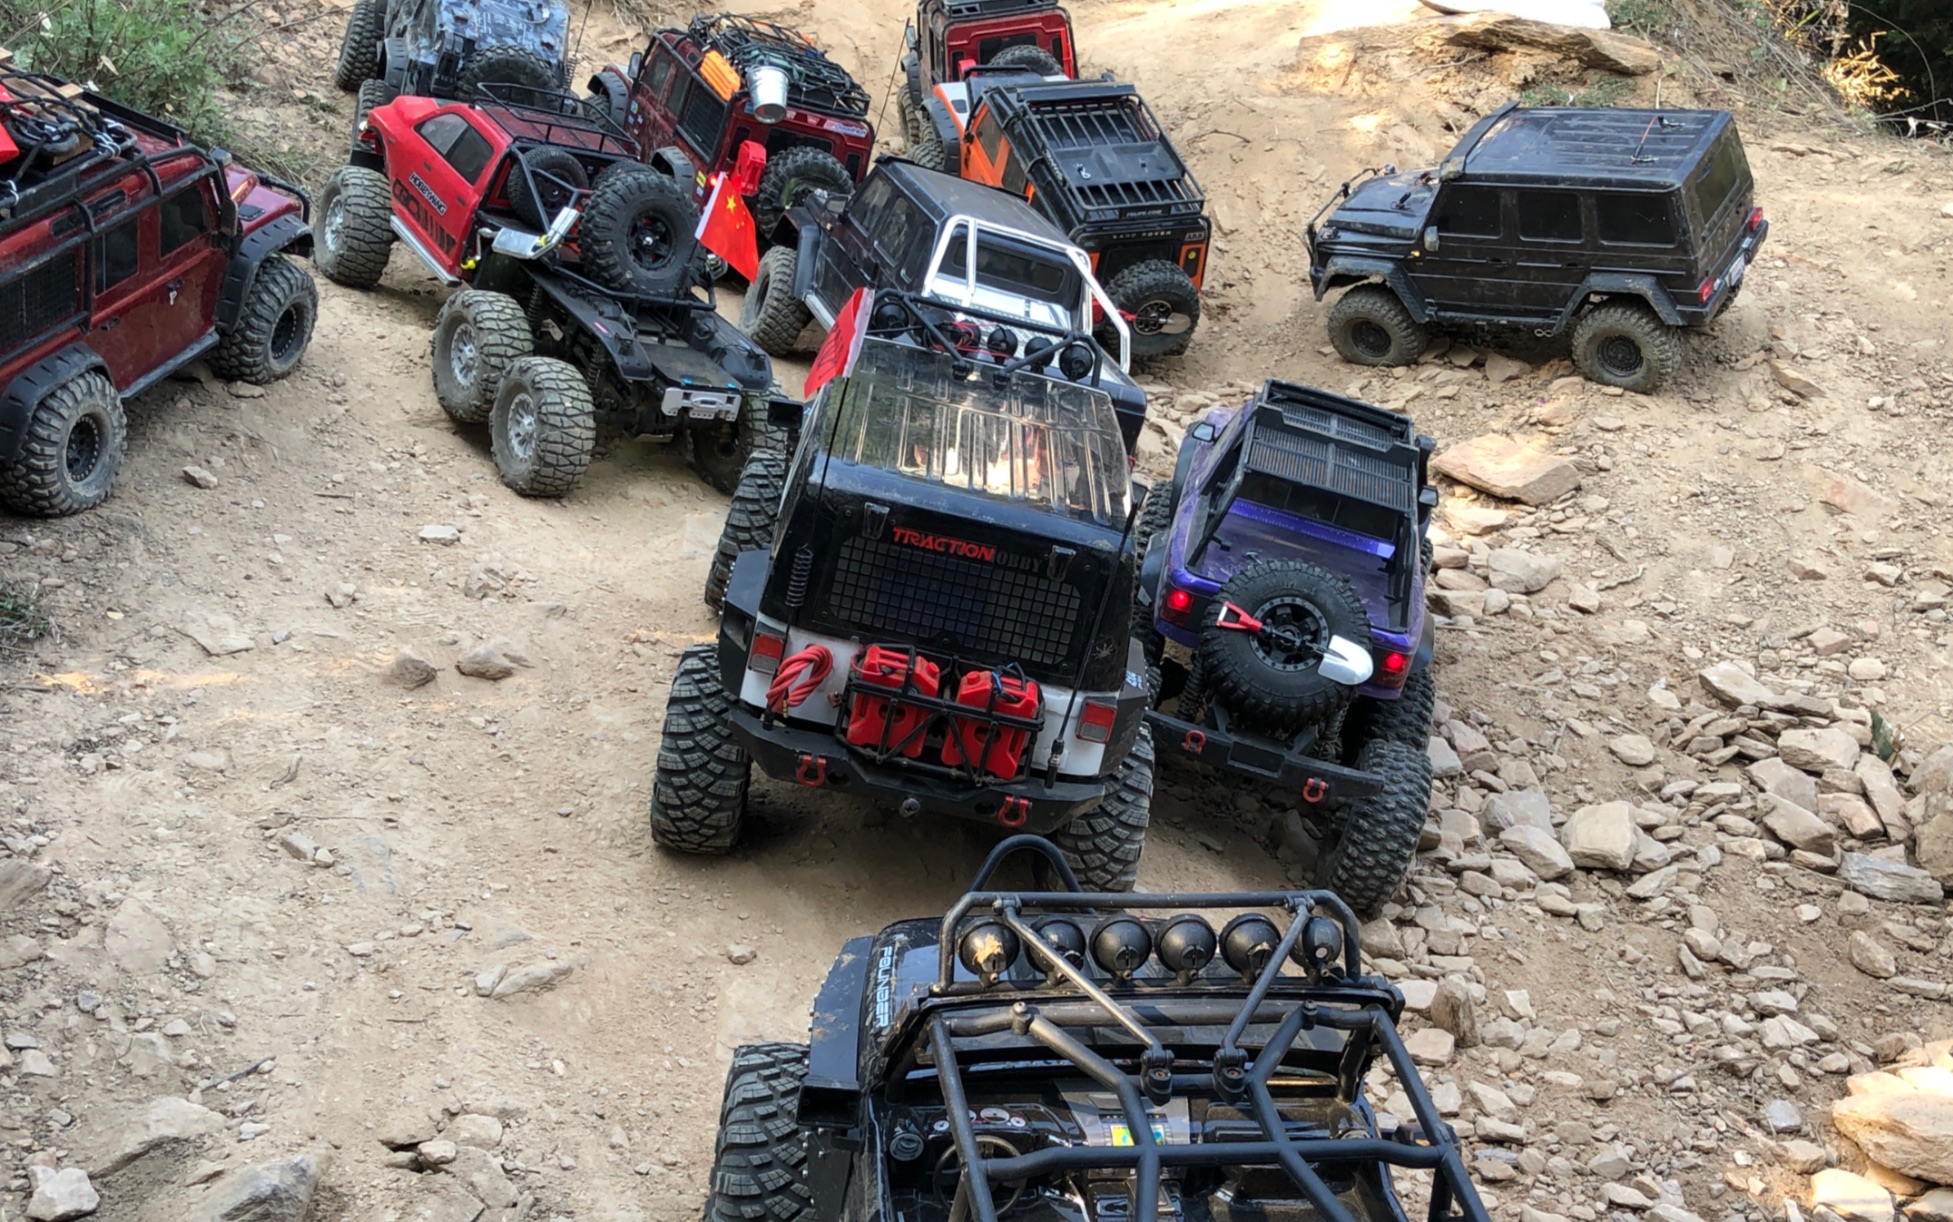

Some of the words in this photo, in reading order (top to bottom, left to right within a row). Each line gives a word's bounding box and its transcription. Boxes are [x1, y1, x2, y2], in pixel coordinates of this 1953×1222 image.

[410, 172, 447, 215] HOBBYWING
[1141, 230, 1172, 238] ROVER
[894, 527, 995, 561] TRACTION
[876, 946, 893, 1028] FOUNDER
